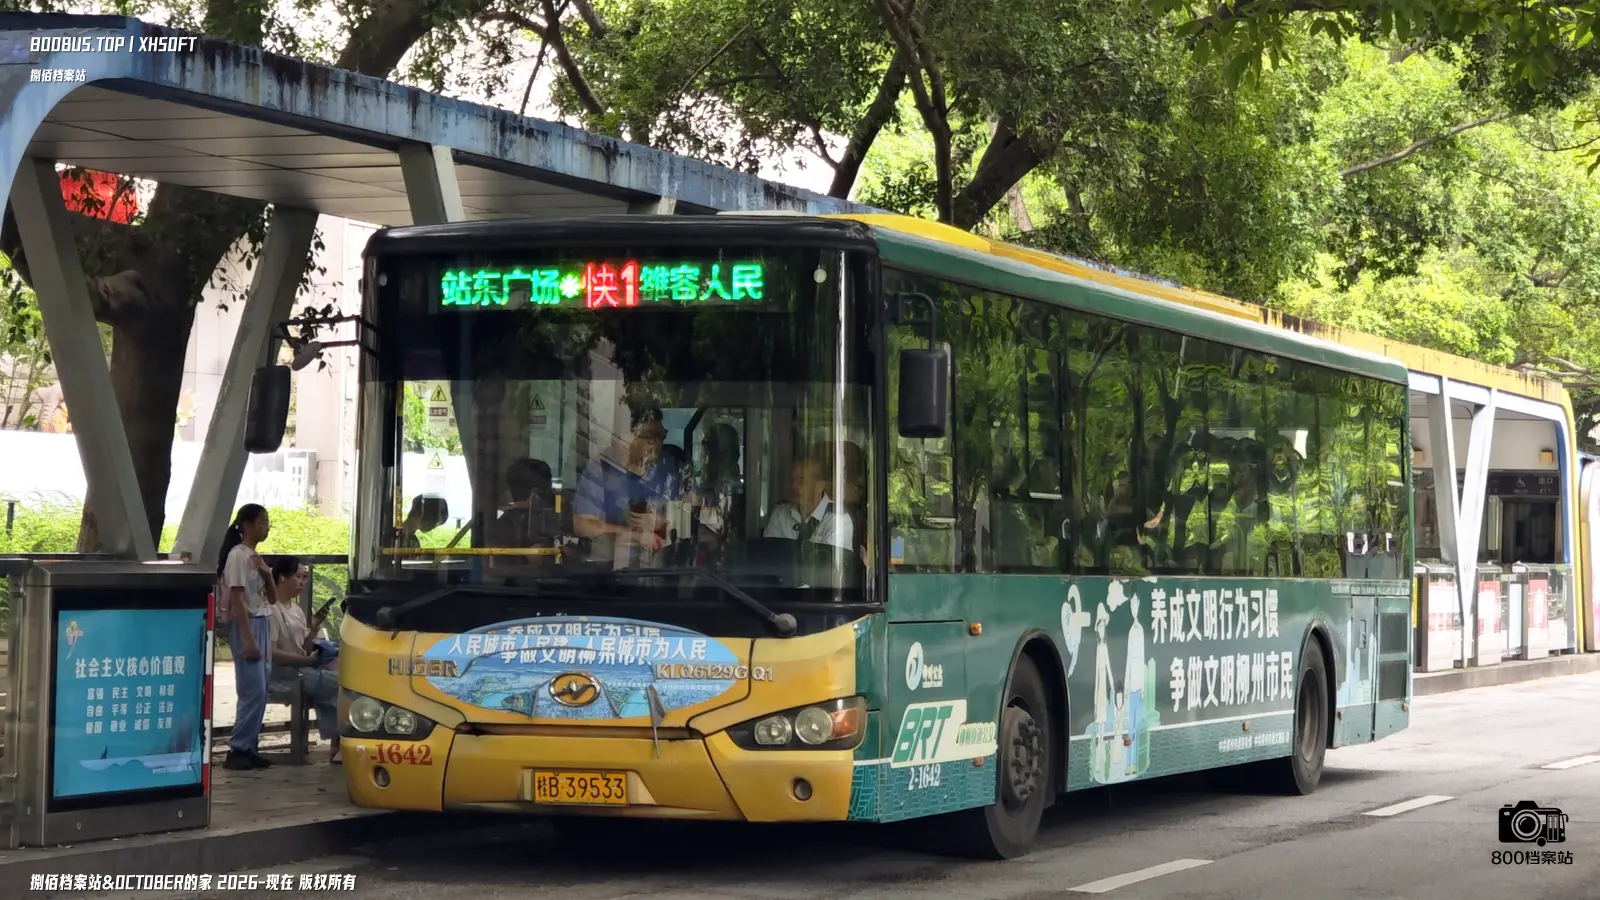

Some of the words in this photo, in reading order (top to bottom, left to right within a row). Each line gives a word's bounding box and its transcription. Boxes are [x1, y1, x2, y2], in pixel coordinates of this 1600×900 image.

[442, 269, 560, 305] 站东广场
[1151, 586, 1279, 645] 养成文明行为习惯
[75, 655, 185, 679] 社会主义核心价值观
[1169, 650, 1293, 713] 争做文明柳州市民
[112, 687, 128, 699] 民主
[136, 685, 152, 698] 文明
[86, 705, 104, 717] 自由
[111, 703, 128, 716] 平等
[135, 702, 151, 714] 公正
[158, 701, 174, 713] 法治
[892, 705, 954, 763] BRT
[908, 764, 941, 791] 2-1642
